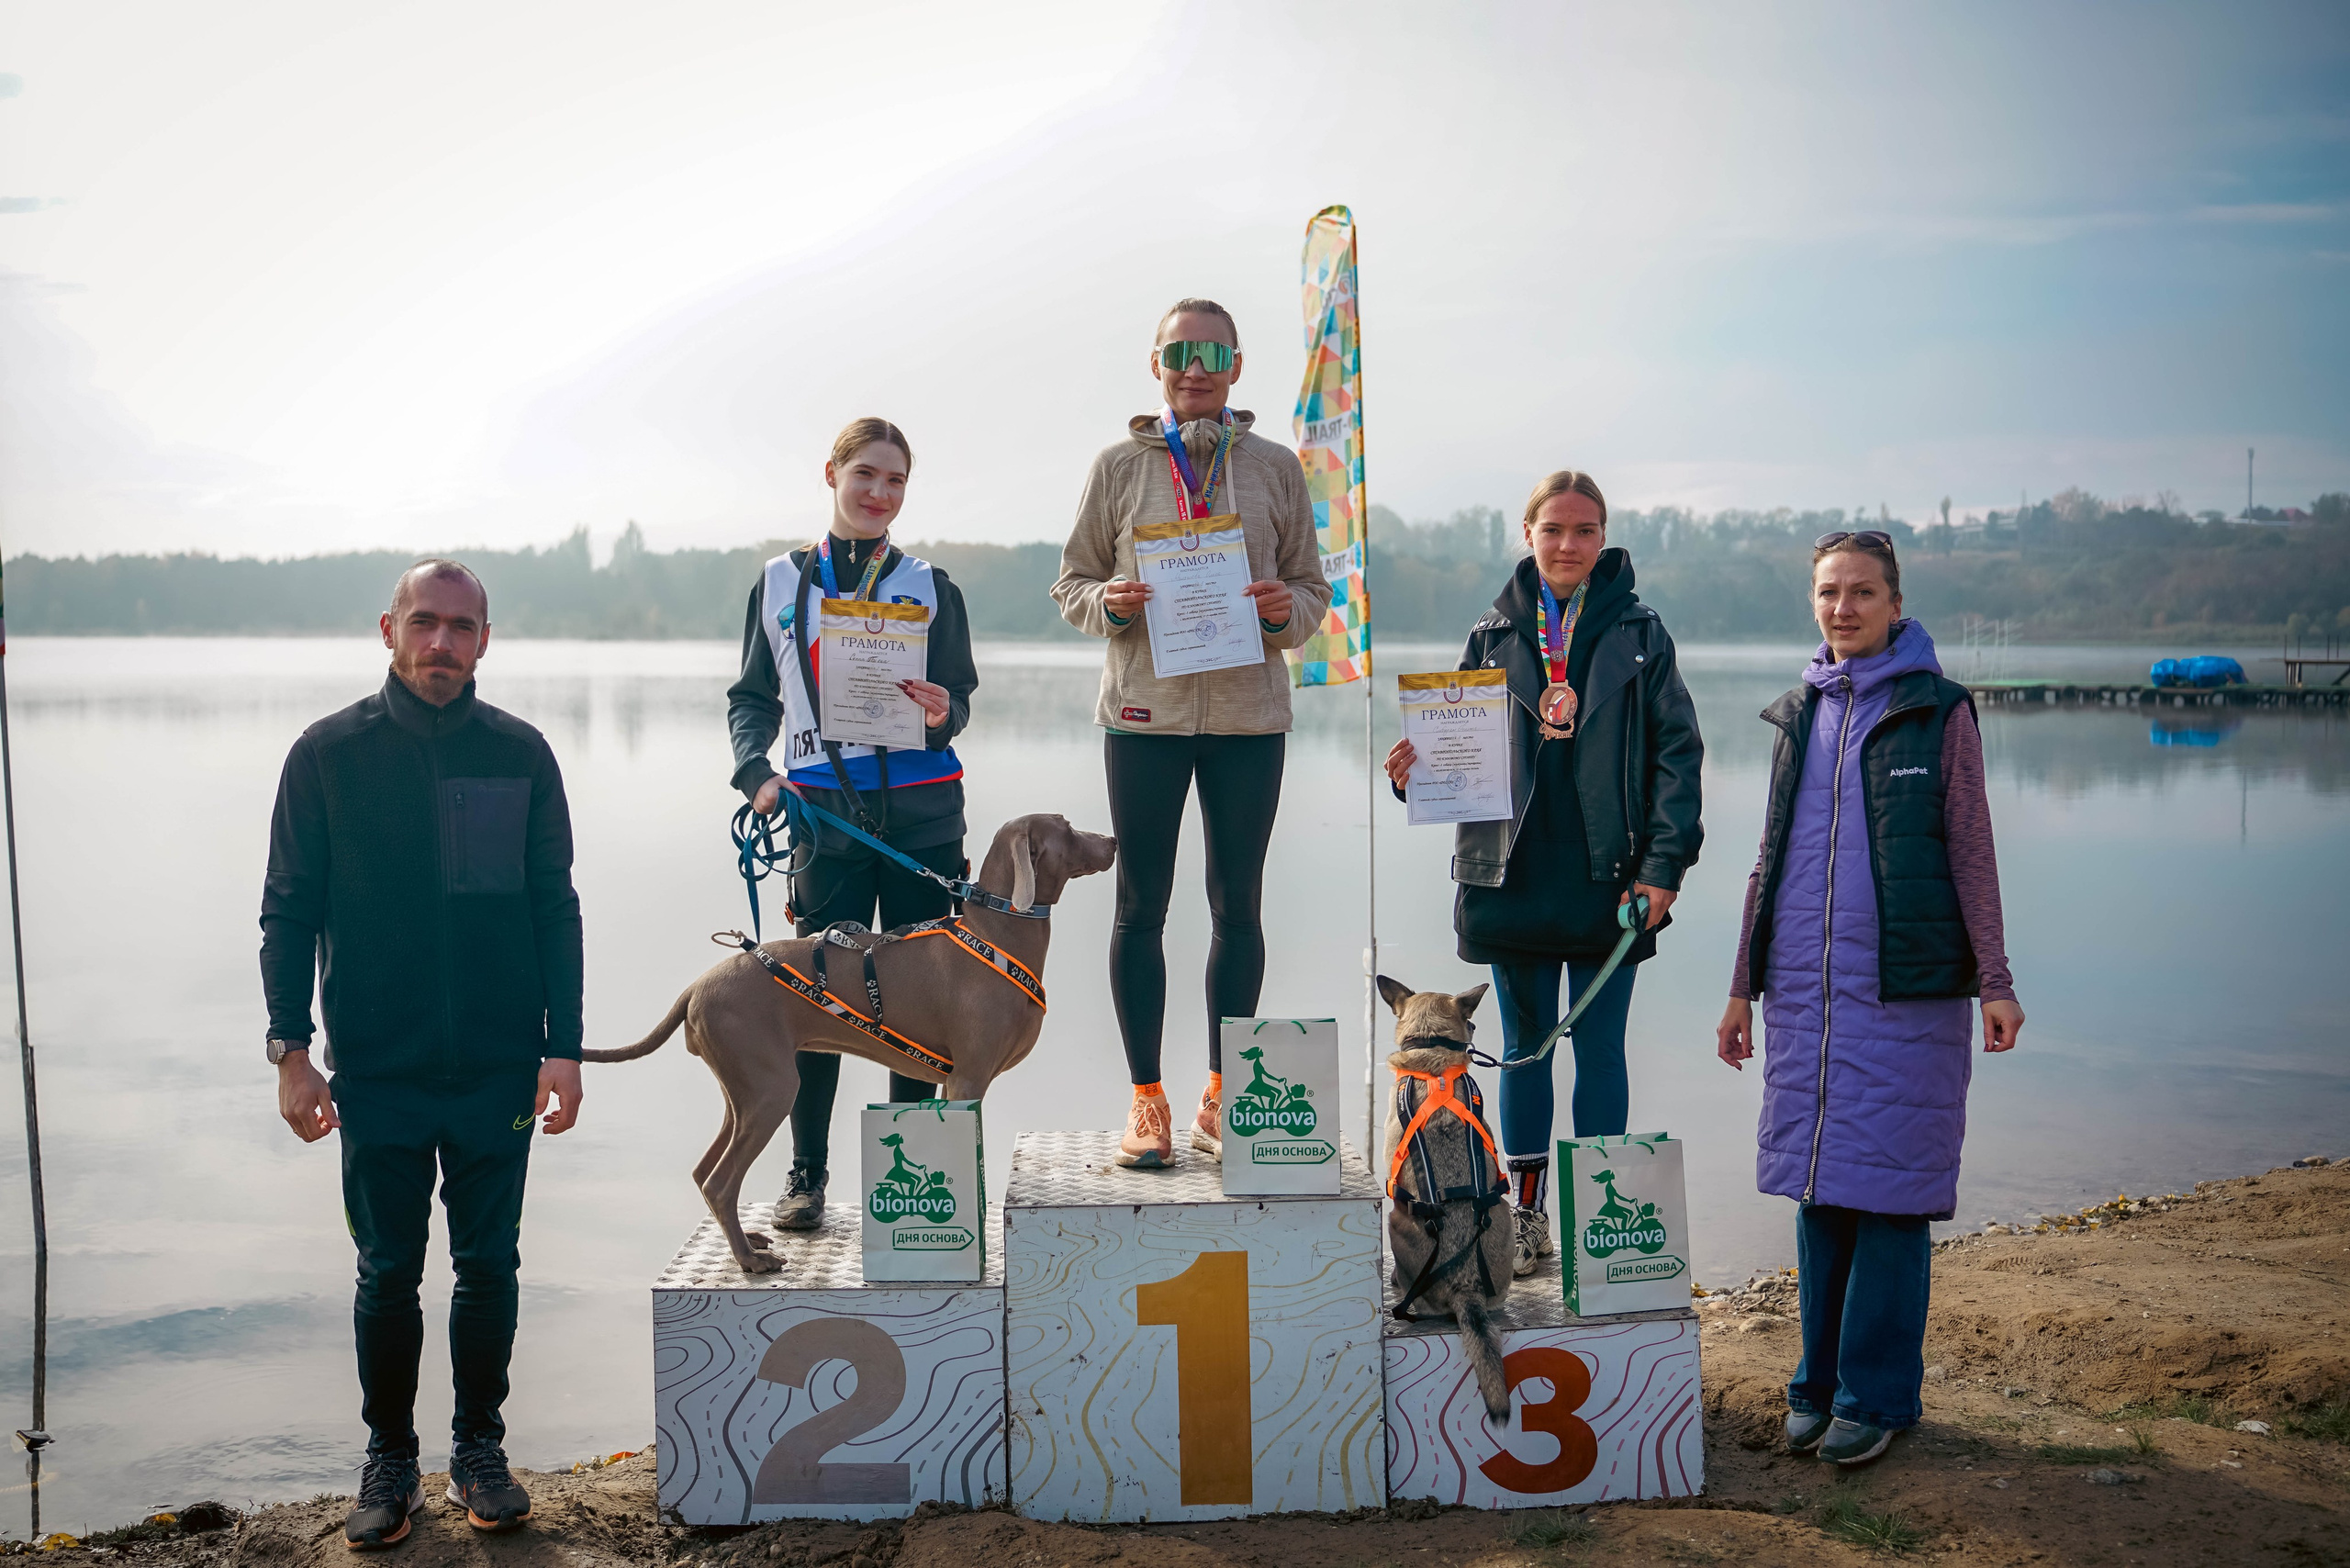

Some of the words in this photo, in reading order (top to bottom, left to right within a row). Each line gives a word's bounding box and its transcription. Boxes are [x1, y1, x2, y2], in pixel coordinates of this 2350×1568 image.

[1160, 552, 1226, 569] ГРАМОТА
[841, 636, 906, 652] ГРАМОТА
[1421, 707, 1487, 721] ГРАМОТА
[1890, 767, 1928, 777] AlphaPet
[963, 933, 992, 958] RACE
[752, 946, 775, 968] RACE
[1017, 970, 1038, 994] RACE
[797, 982, 830, 1006] RACE
[856, 1019, 887, 1039] RACE
[912, 1049, 945, 1070] RACE
[1232, 1106, 1315, 1126] bionova
[1256, 1147, 1279, 1158] ДНЯ
[1281, 1147, 1326, 1157] ОСНОВА
[872, 1192, 955, 1213] bionova
[897, 1233, 920, 1244] ДНЯ
[922, 1233, 966, 1243] ОСНОВА
[1585, 1227, 1664, 1249] bionova
[1611, 1266, 1633, 1278] ДНЯ
[1635, 1261, 1677, 1274] ОСНОВА
[1136, 1250, 1253, 1506] 1
[753, 1316, 911, 1506] 2
[1477, 1347, 1598, 1495] 3
